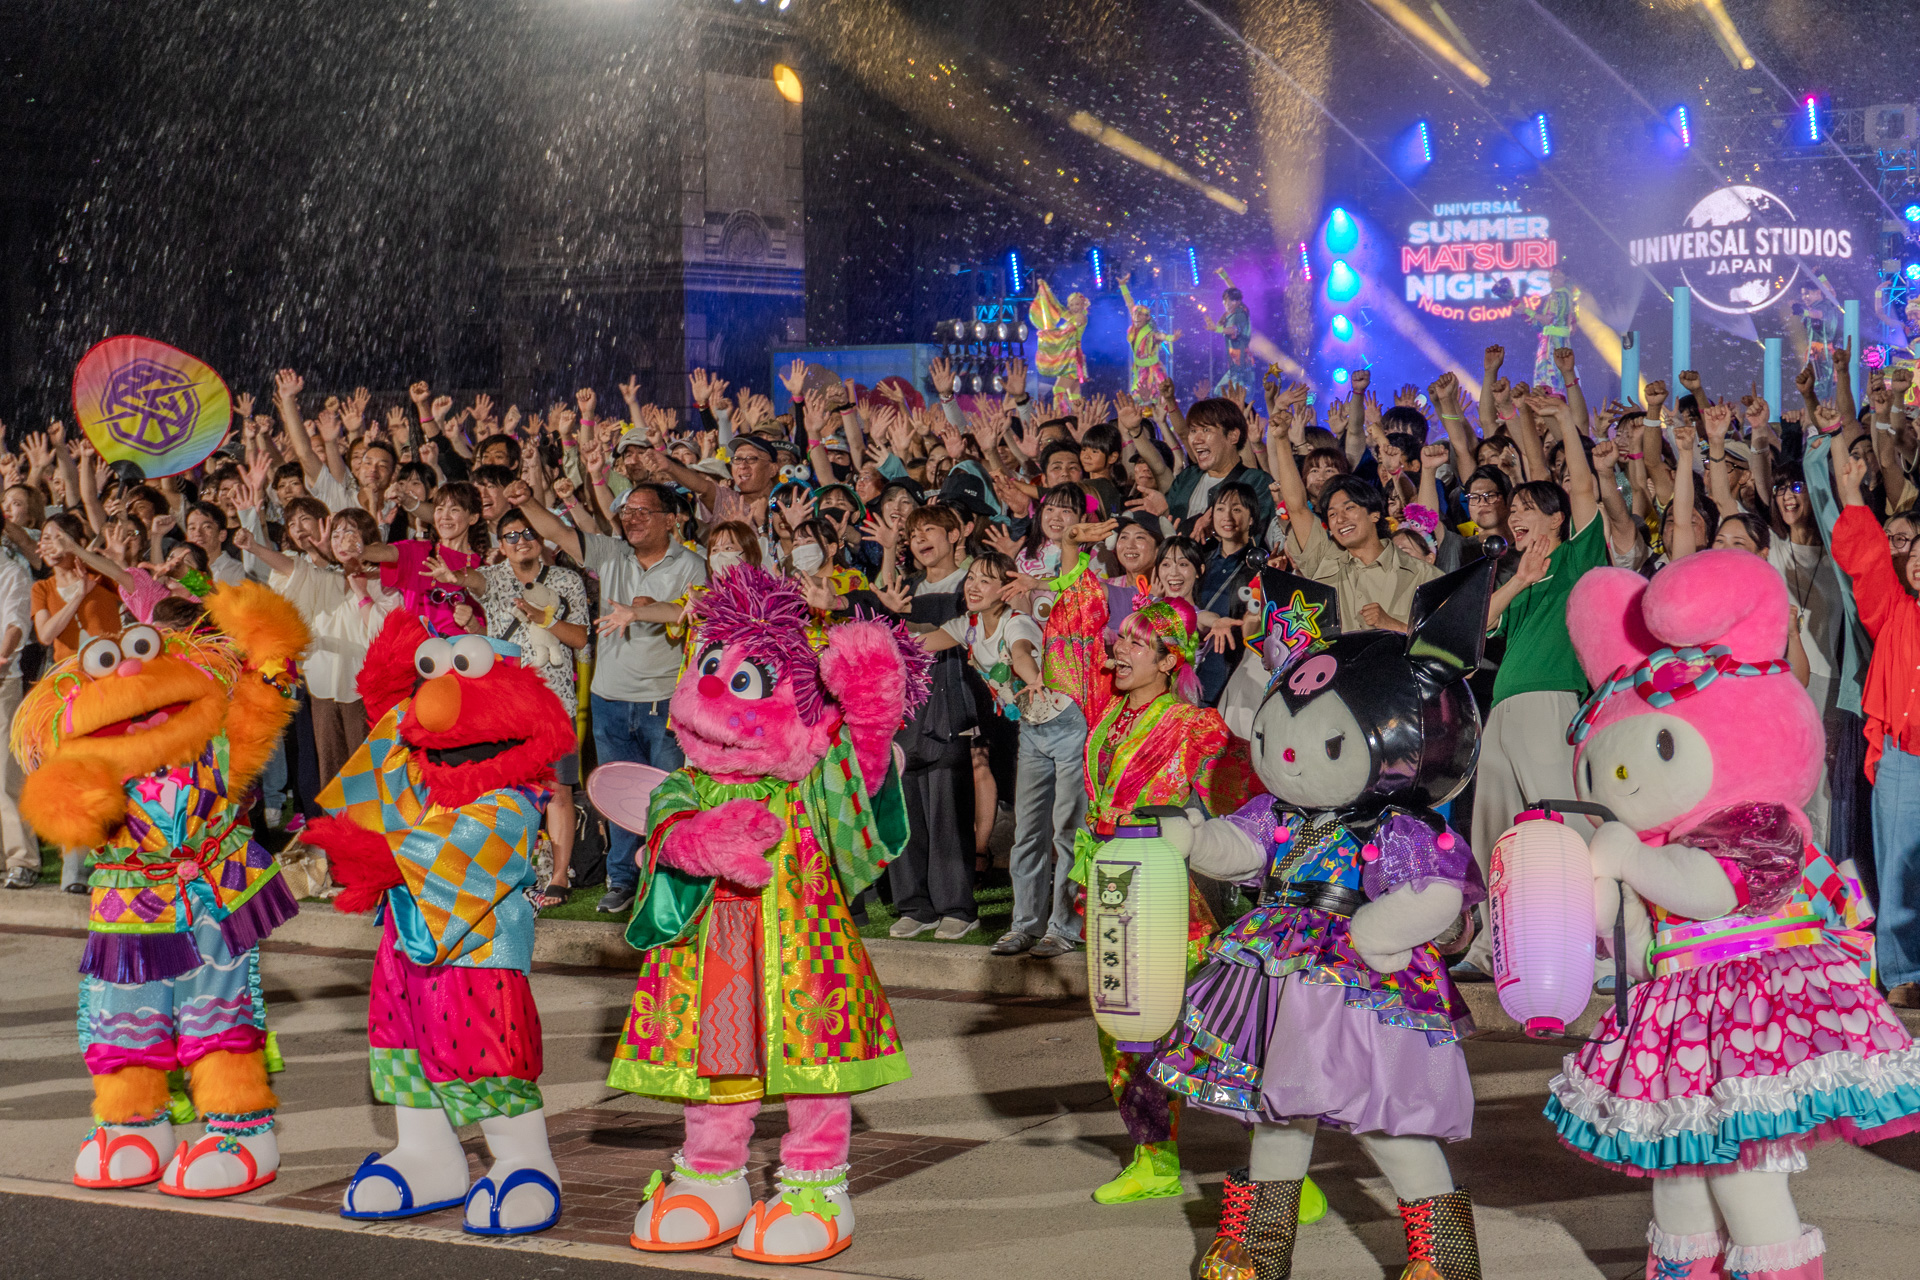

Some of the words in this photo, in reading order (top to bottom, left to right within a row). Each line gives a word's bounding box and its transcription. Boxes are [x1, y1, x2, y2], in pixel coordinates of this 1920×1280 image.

[1433, 201, 1523, 216] UNIVERSAL
[1408, 216, 1549, 245] SUMMER
[1402, 240, 1557, 274] MATSURI
[1629, 229, 1749, 267] UNIVERSAL
[1755, 227, 1852, 258] STUDIOS
[1706, 258, 1772, 276] JAPAN
[1405, 270, 1552, 302] NIGHTS
[1418, 295, 1464, 320] Neon
[1468, 305, 1512, 322] Glow
[771, 442, 794, 450] ELLO!
[1103, 927, 1120, 991] くろみ
